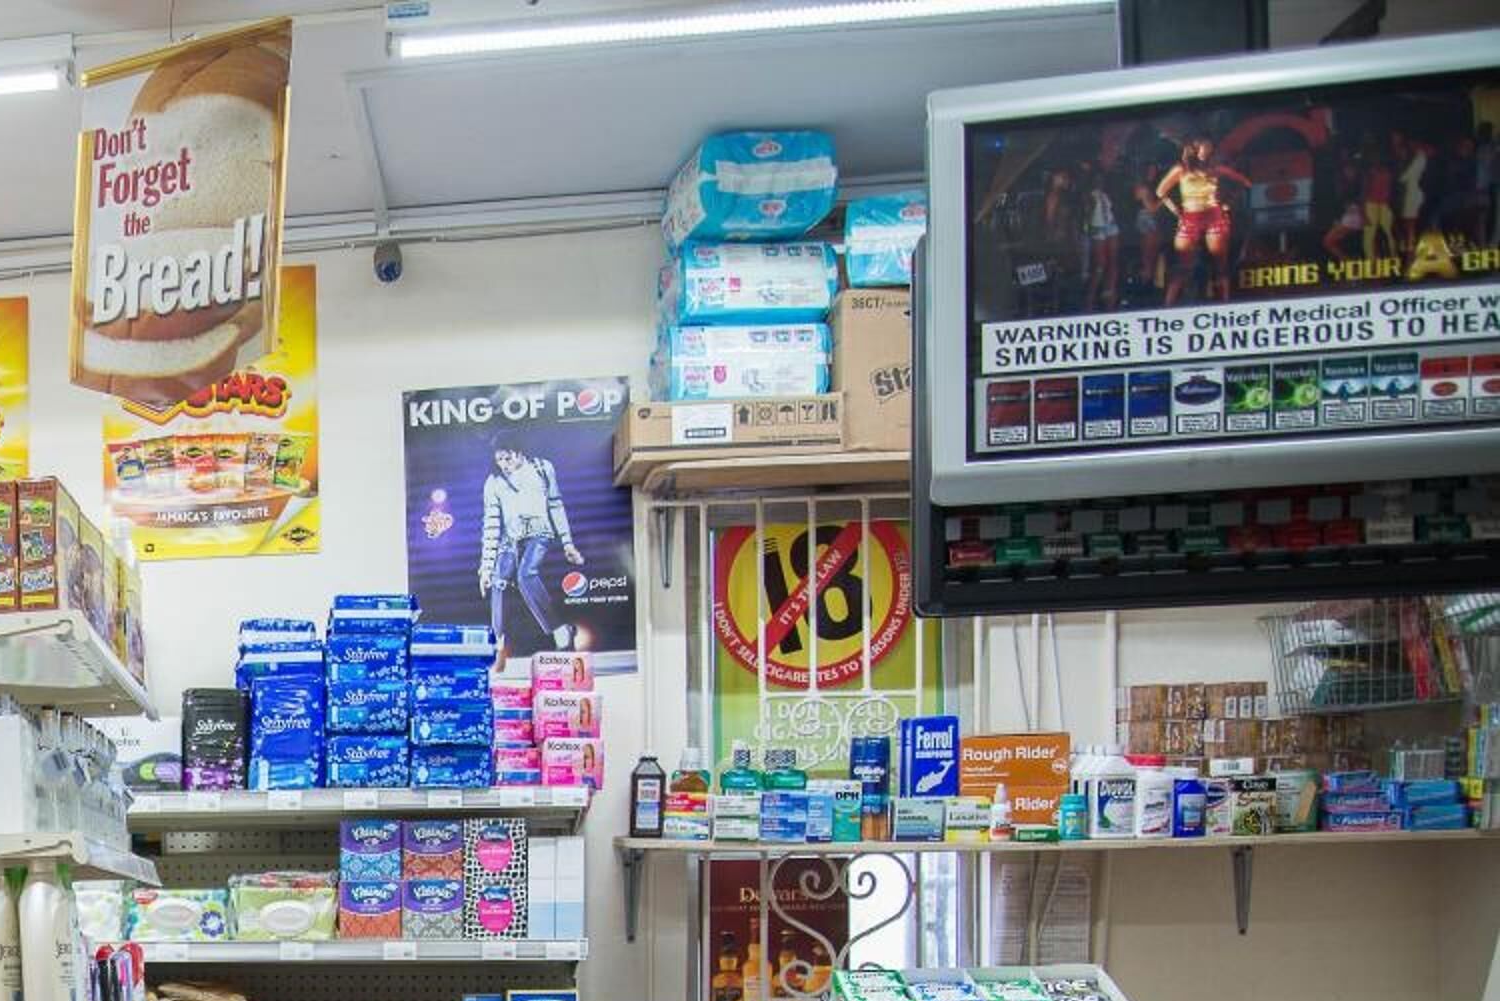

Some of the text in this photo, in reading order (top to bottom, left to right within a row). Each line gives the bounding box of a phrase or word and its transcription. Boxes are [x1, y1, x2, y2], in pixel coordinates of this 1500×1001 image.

[93, 118, 147, 161] Don't
[98, 149, 191, 206] Forget
[123, 213, 151, 237] the
[93, 213, 268, 324] Bread!
[1240, 264, 1320, 288] BRING
[1328, 258, 1402, 281] YOUR
[996, 294, 1470, 345] WARNING: The Chief Medical Officer
[996, 311, 1500, 367] SMOKING IS DANGEROUS TO HEA
[409, 396, 493, 428] KING
[503, 394, 545, 420] OF
[155, 509, 210, 523] JAMAICA'S
[589, 575, 628, 592] pepsi
[344, 647, 389, 662] Stayfree
[765, 661, 840, 683] CIGARETES
[840, 662, 860, 677] TO
[344, 689, 389, 705] Stayfree
[544, 696, 577, 707] Kotex
[548, 740, 580, 752] Kotex
[916, 725, 954, 749] Ferrol
[344, 746, 391, 762] Stayfree
[963, 744, 1055, 764] Rough Rider
[835, 791, 862, 802] DPH
[1015, 797, 1055, 811] Rider
